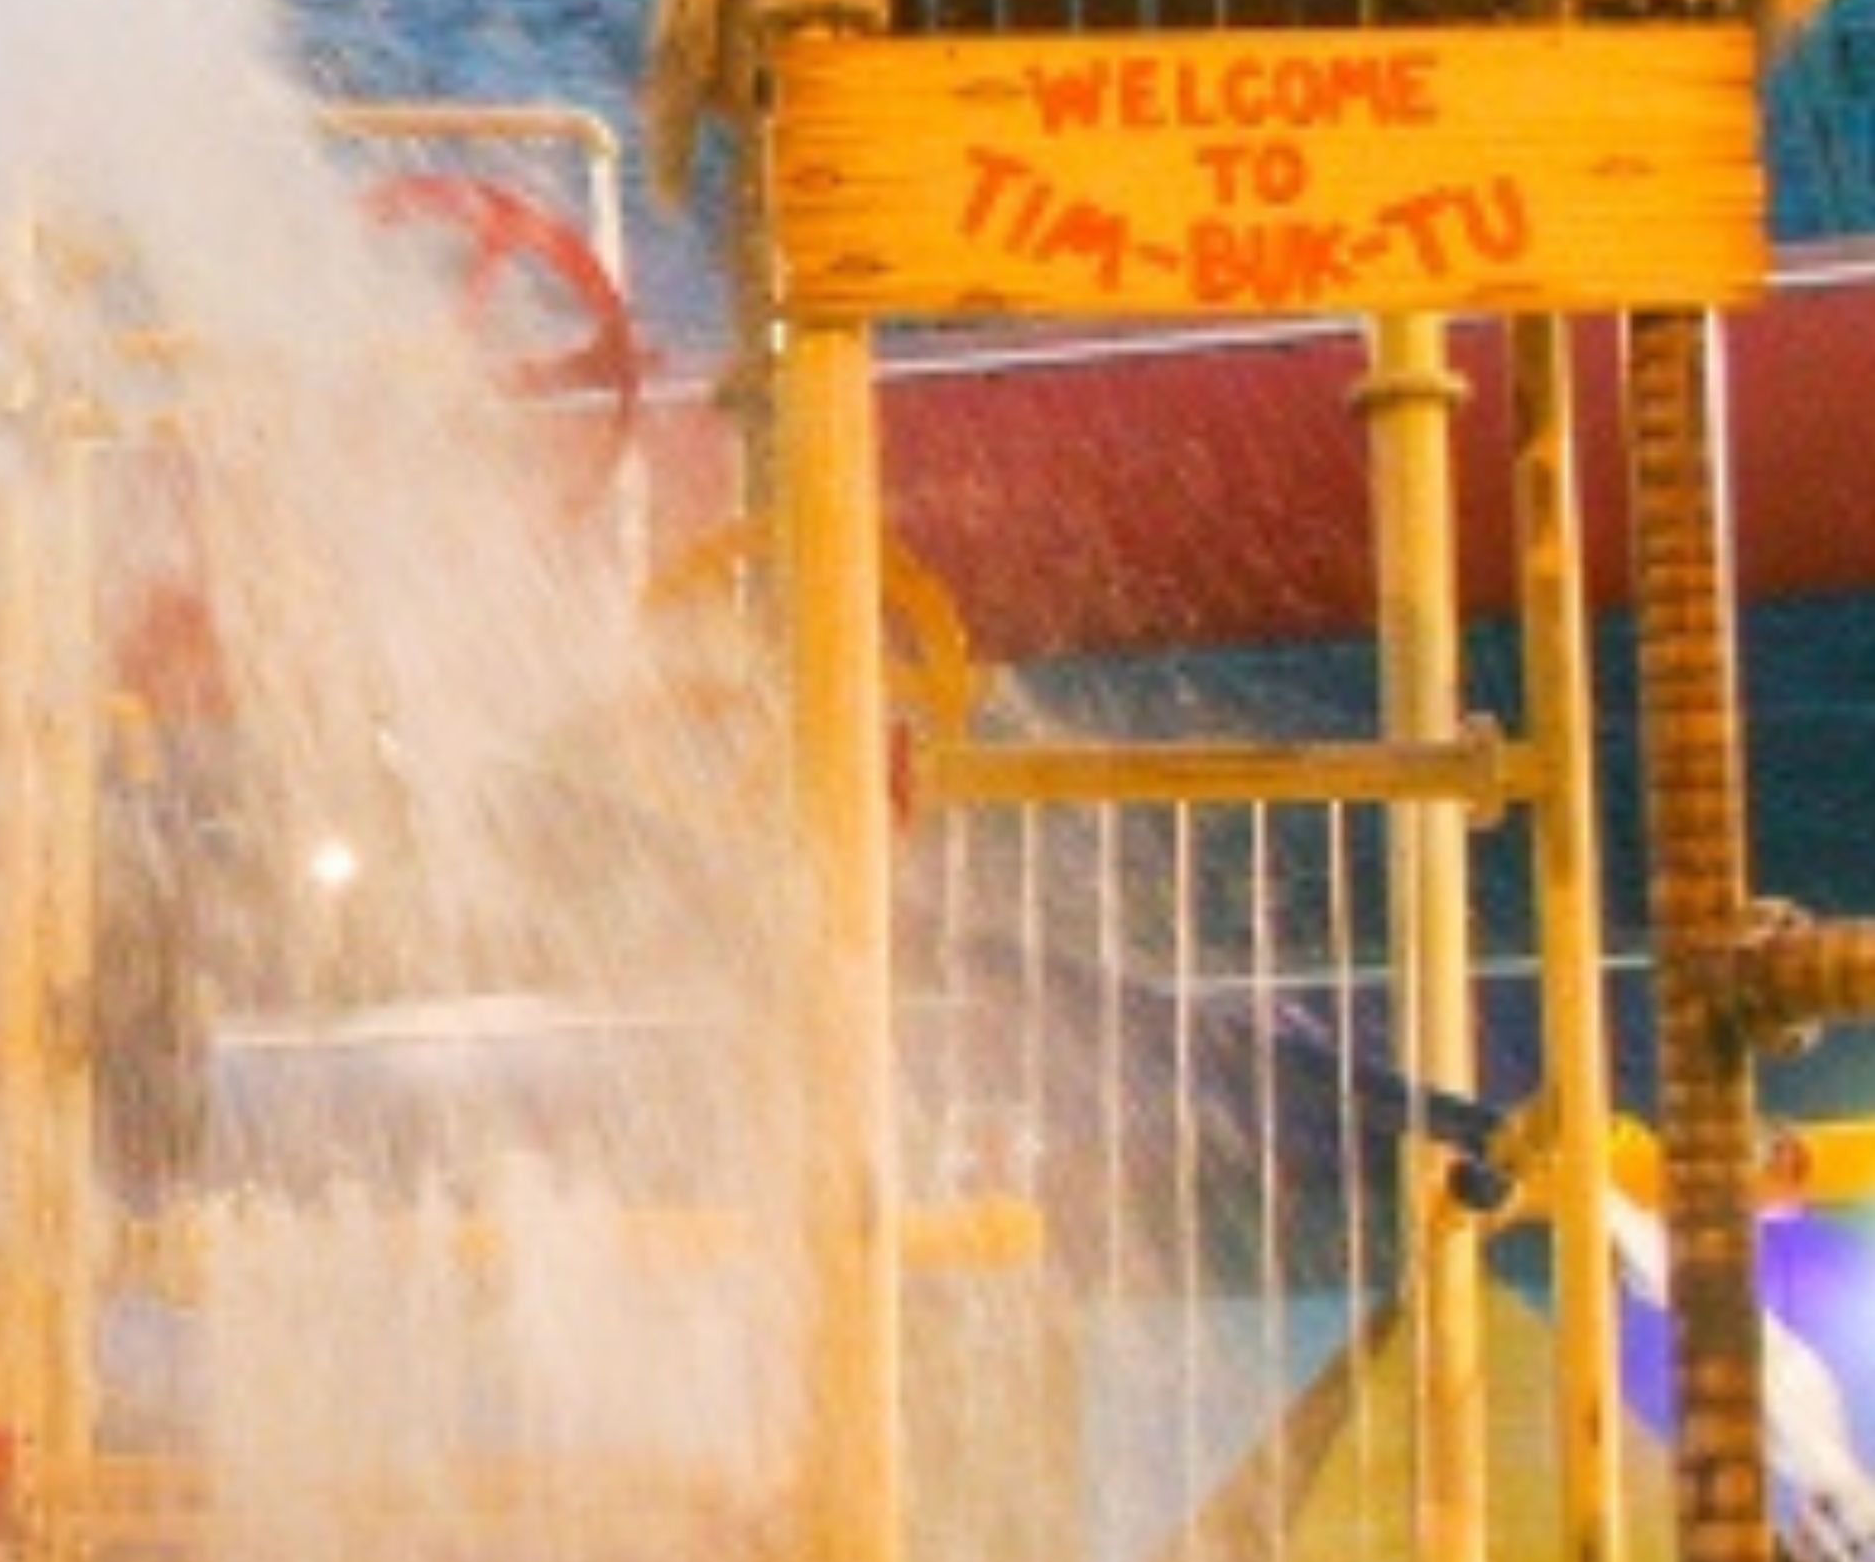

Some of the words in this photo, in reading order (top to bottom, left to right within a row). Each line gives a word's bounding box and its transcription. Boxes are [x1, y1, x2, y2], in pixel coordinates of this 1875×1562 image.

[1027, 53, 1438, 134] WELCOME
[1199, 145, 1307, 206] TO
[960, 146, 1533, 304] TIM-BUK-TU
